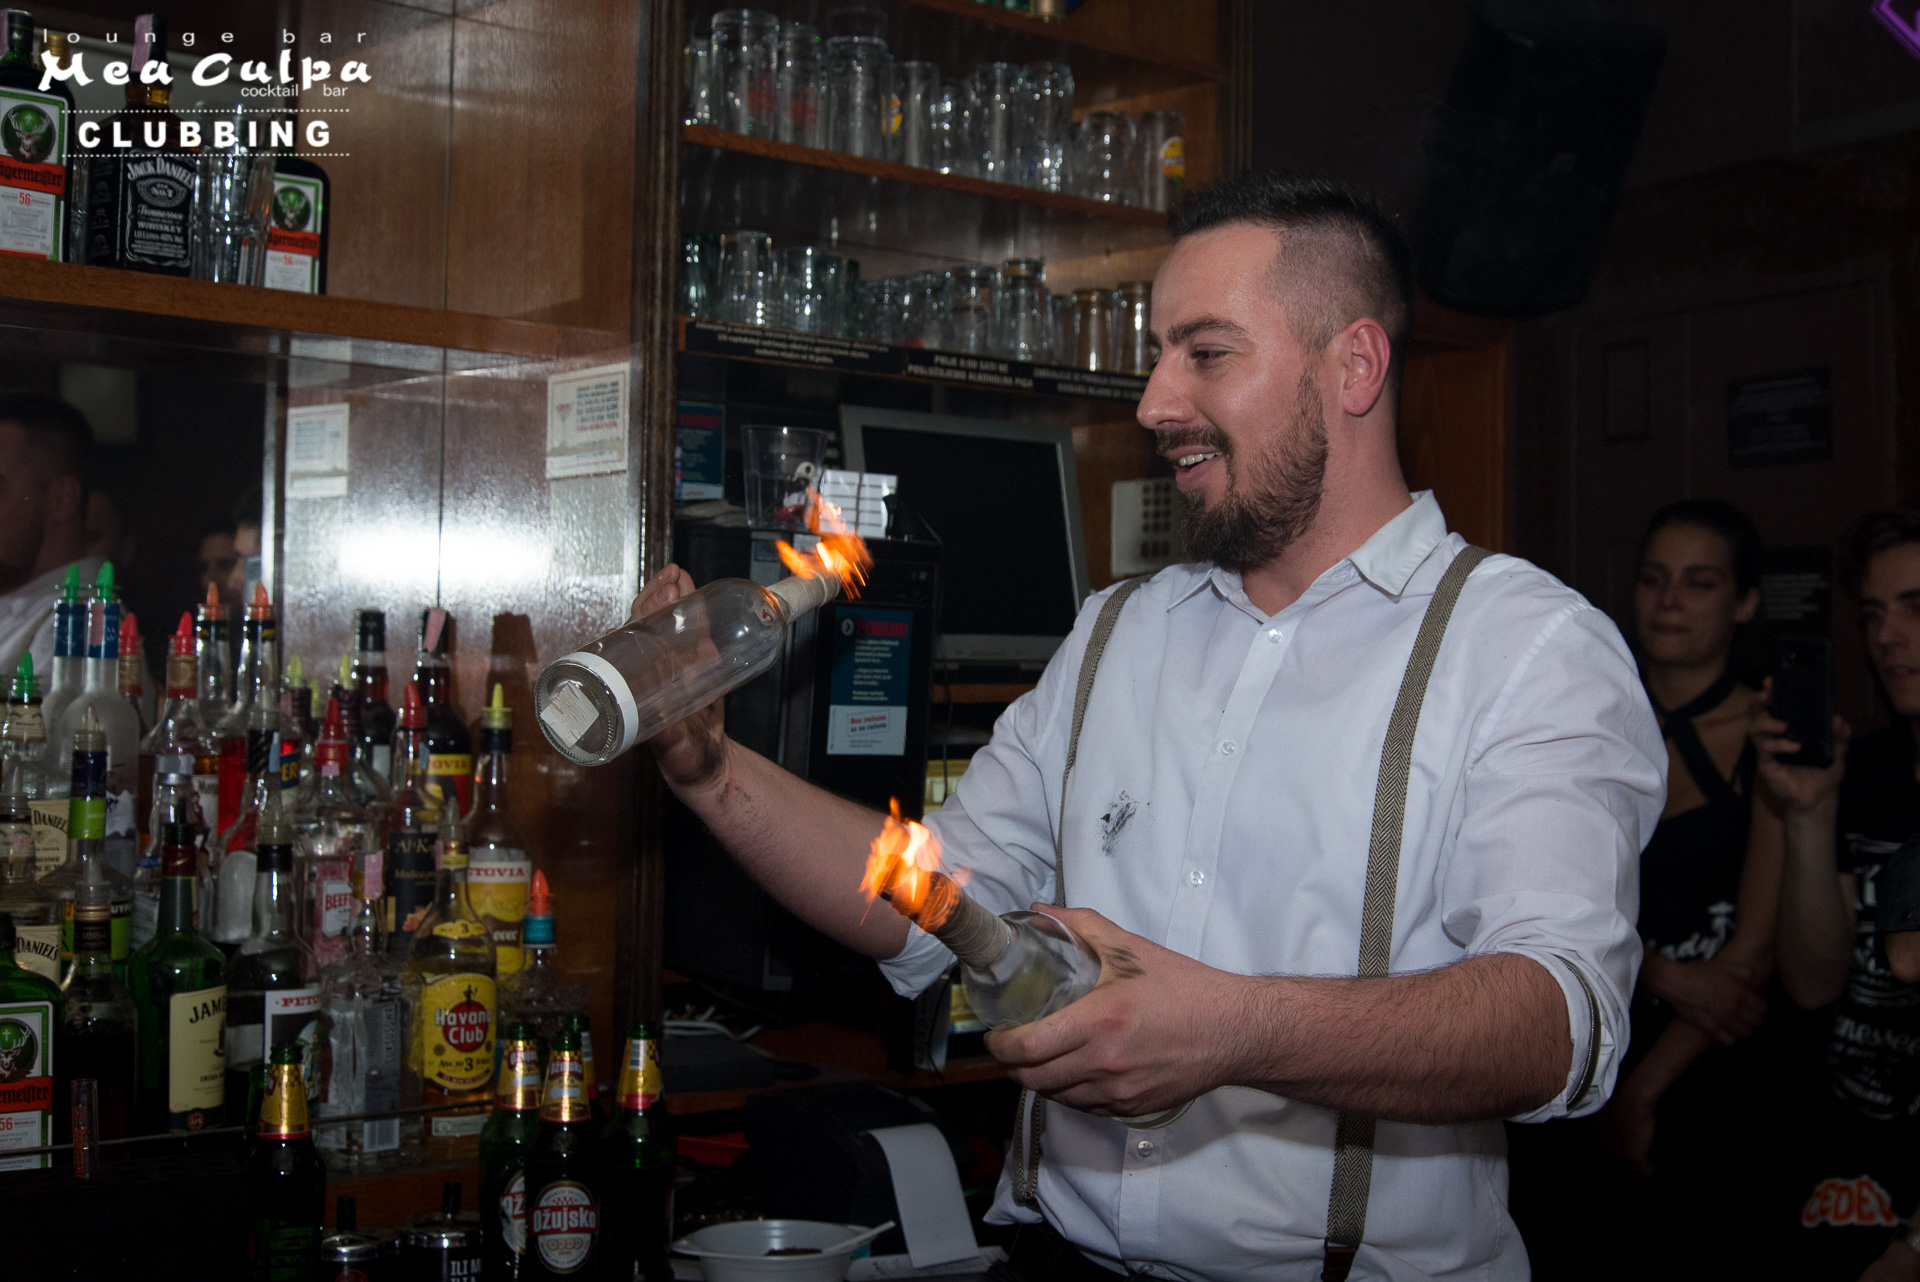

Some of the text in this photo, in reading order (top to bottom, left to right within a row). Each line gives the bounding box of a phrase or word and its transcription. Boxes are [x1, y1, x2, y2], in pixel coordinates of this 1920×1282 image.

[127, 160, 156, 181] JACK
[19, 192, 31, 206] 56
[434, 1009, 493, 1027] Havana
[447, 1028, 484, 1044] Club
[533, 1207, 597, 1234] Ožujsko
